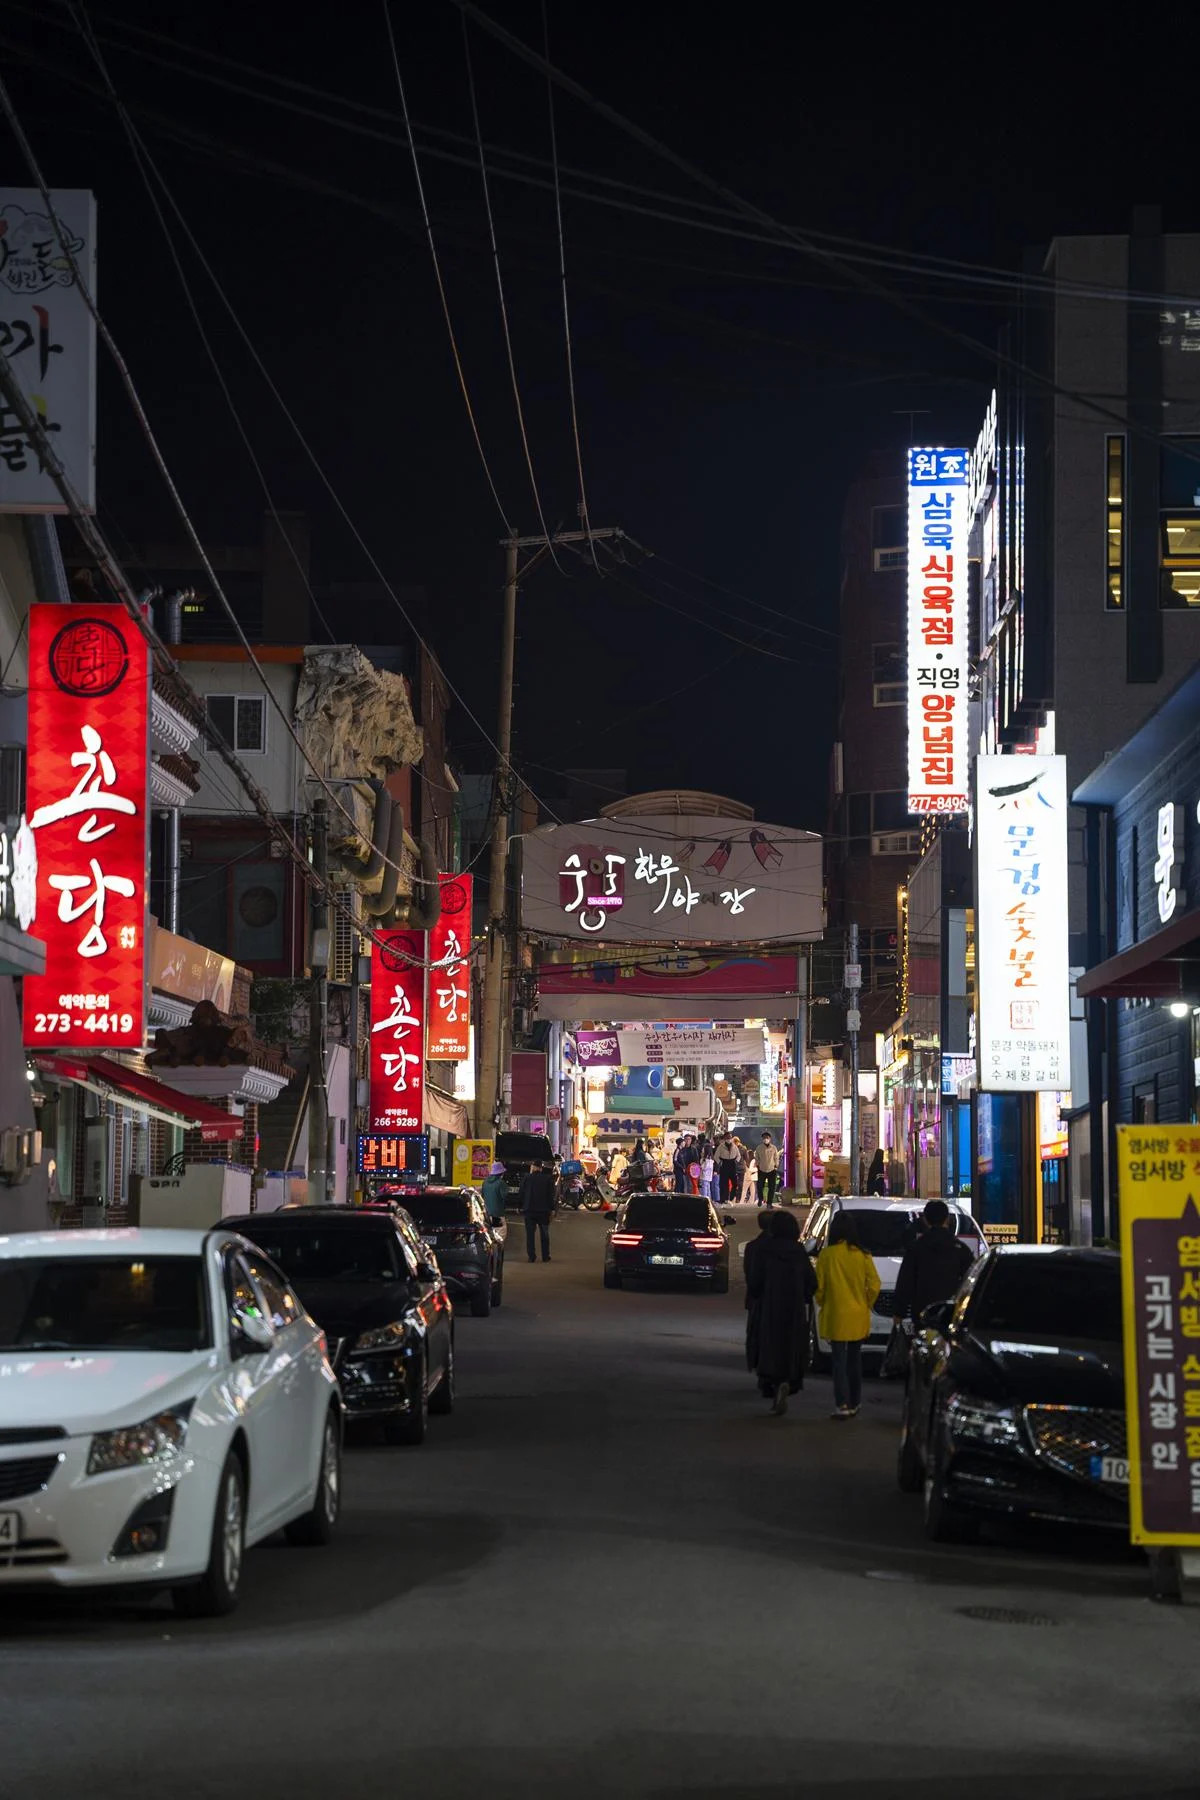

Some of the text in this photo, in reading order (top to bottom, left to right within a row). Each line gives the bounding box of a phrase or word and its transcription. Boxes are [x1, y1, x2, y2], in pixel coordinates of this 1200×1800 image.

[914, 453, 966, 481] 원조
[916, 666, 960, 689] 직영
[921, 693, 955, 786] 양념집
[910, 796, 967, 812] 277-8496
[31, 724, 137, 958] 촌당
[588, 897, 604, 905] Since
[34, 1013, 134, 1033] 273-4419
[372, 984, 420, 1092] 촌당
[430, 1045, 466, 1053] 266-9289
[374, 1117, 418, 1127] 266-9289
[1129, 1160, 1186, 1181] 염서방
[1145, 1275, 1179, 1470] 고기는 시장 안
